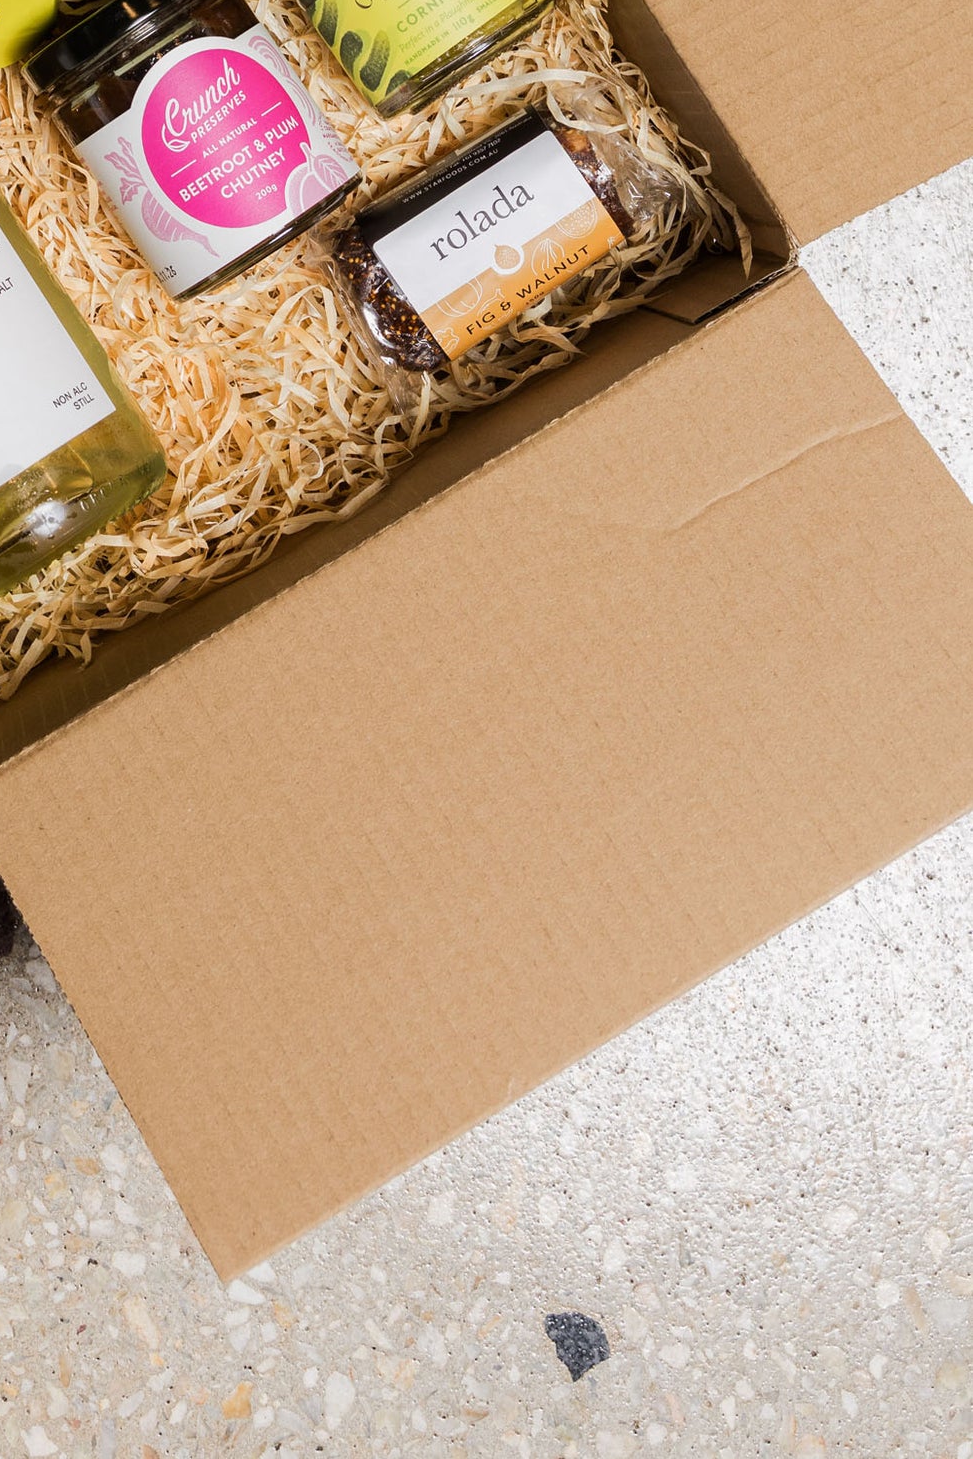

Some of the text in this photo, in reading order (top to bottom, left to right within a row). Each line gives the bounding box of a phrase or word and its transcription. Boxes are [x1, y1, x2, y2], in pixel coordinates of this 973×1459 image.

[164, 57, 241, 138] Crunch
[190, 90, 247, 143] PRESERVES
[178, 115, 299, 203] BEETROOT & PLUM
[201, 118, 258, 159] ALL NATURAL
[220, 147, 286, 199] CHUTNEY
[255, 184, 278, 200] 200g
[429, 185, 535, 261] rolada
[466, 244, 588, 335] FIG & WALNUT
[52, 382, 88, 408] NON ALC
[73, 394, 95, 410] STILL
